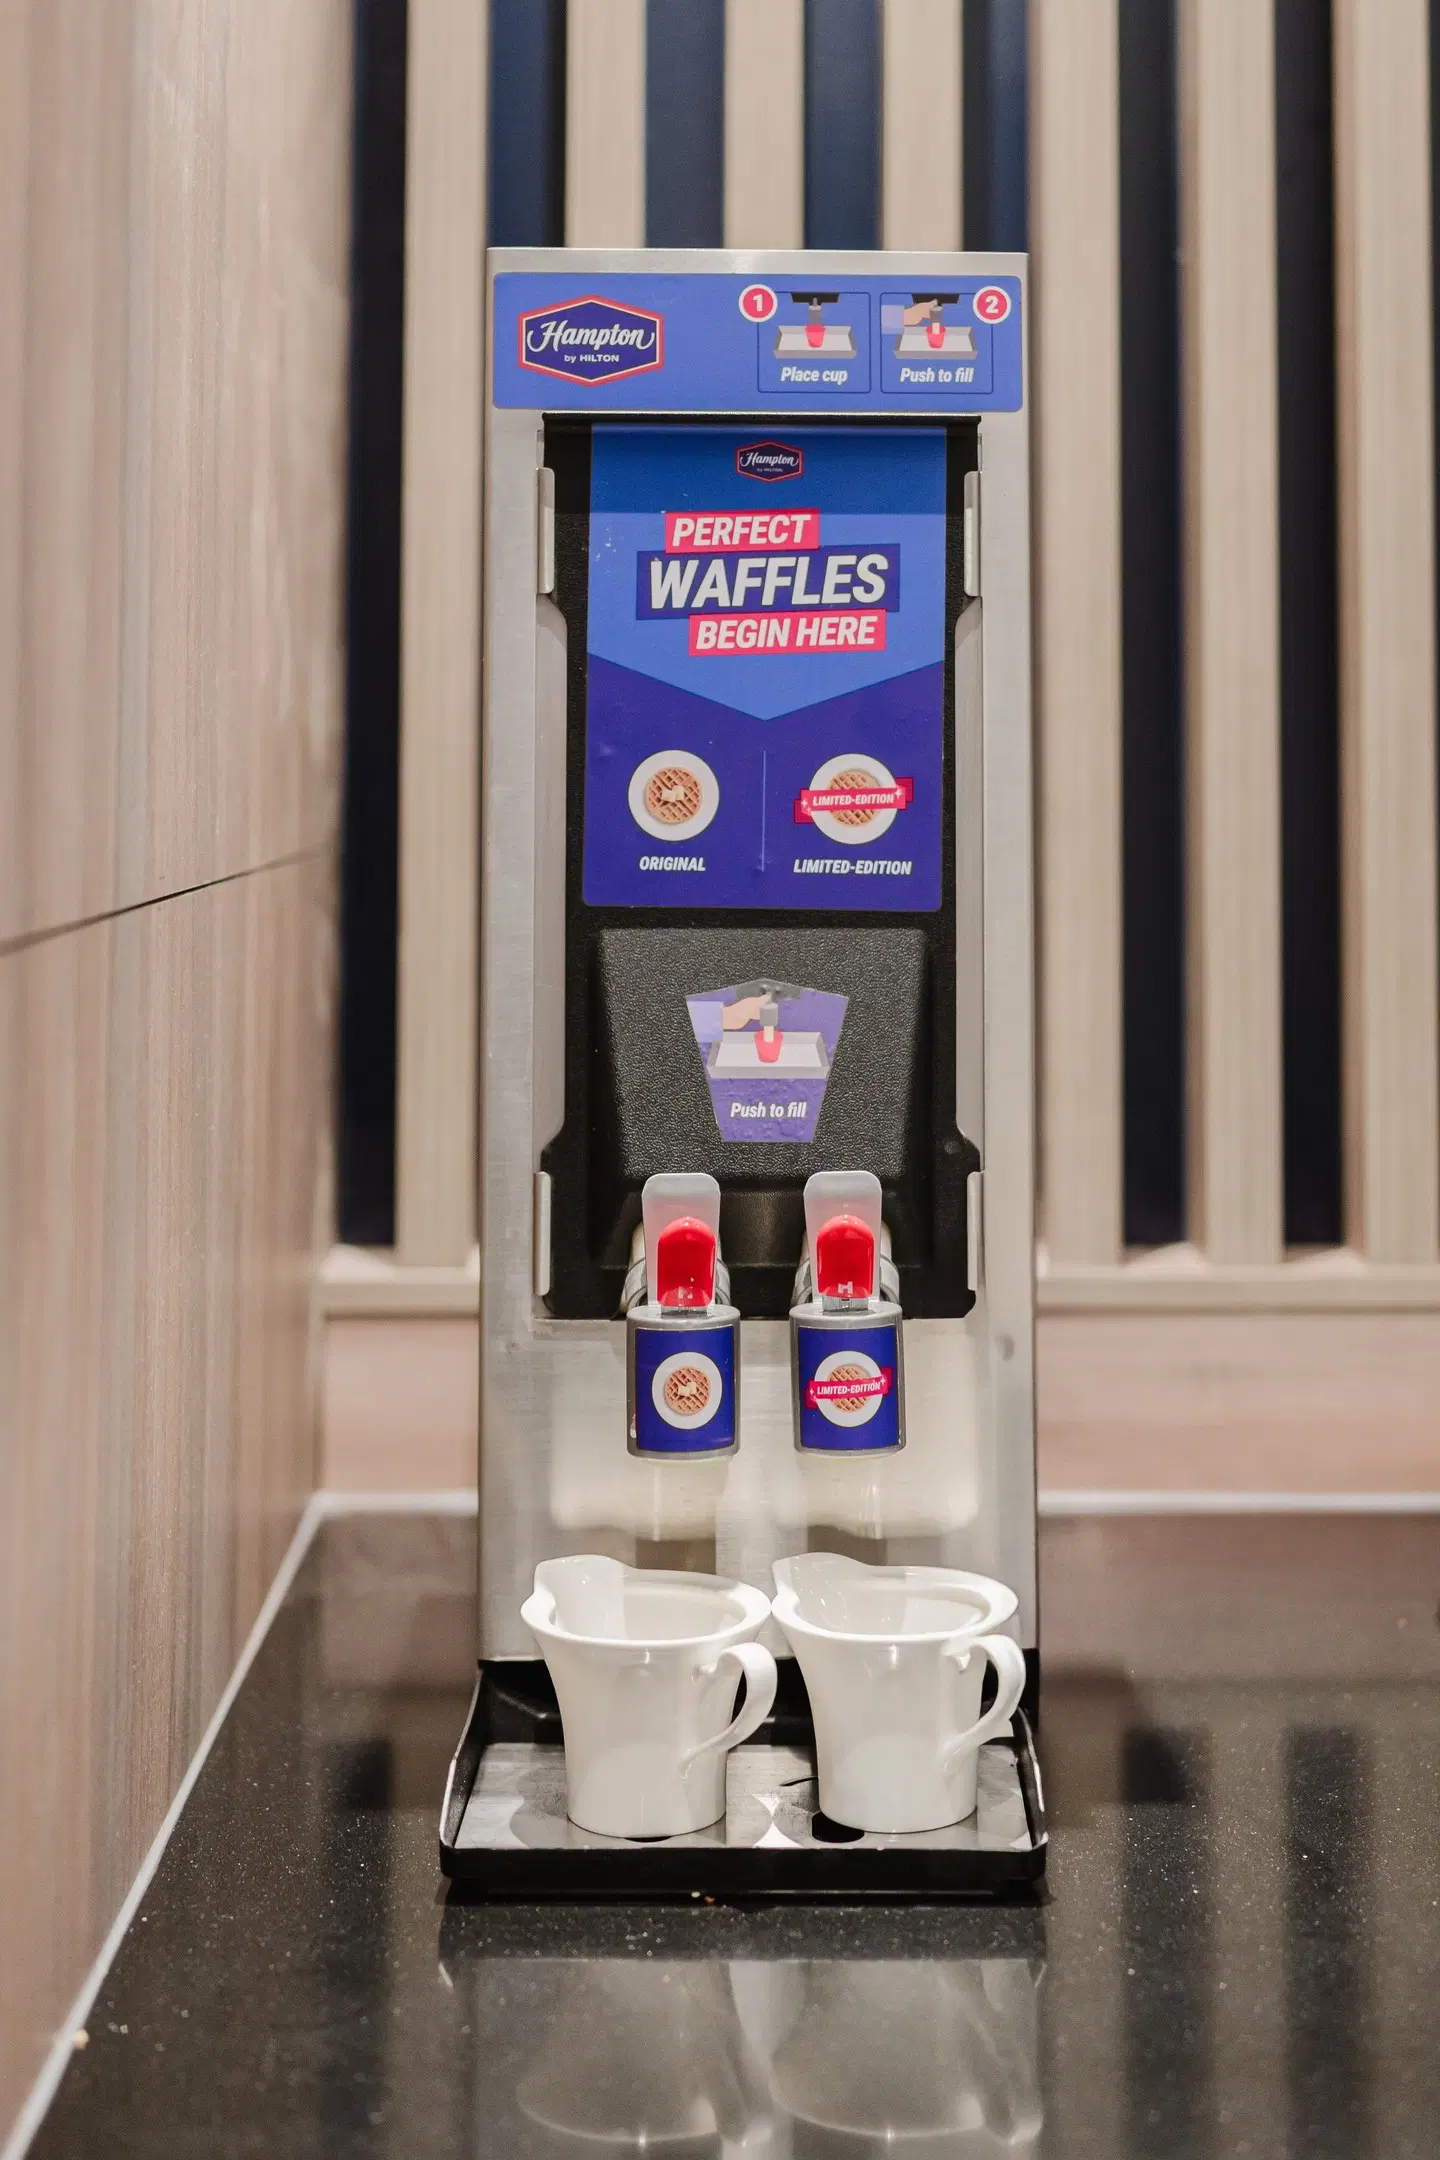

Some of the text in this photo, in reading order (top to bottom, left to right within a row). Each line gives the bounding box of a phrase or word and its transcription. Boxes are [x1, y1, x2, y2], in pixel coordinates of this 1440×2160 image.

[752, 294, 764, 312] 1
[985, 295, 999, 314] 2
[526, 319, 656, 353] Hampton
[563, 354, 620, 364] by HILTON
[780, 366, 848, 386] Place cup
[900, 367, 975, 383] Push to fill
[740, 452, 800, 467] Hampton
[672, 514, 811, 547] PERFECT
[650, 553, 889, 610] WAFFLES
[695, 615, 878, 650] BEGIN HERE
[812, 792, 895, 807] LIMITED-EDITION
[639, 855, 706, 872] ORIGINAL
[793, 858, 912, 876] LIMITED-EDITION
[730, 1102, 807, 1118] Push to fill
[816, 1381, 881, 1396] LIMITED-EDITION
